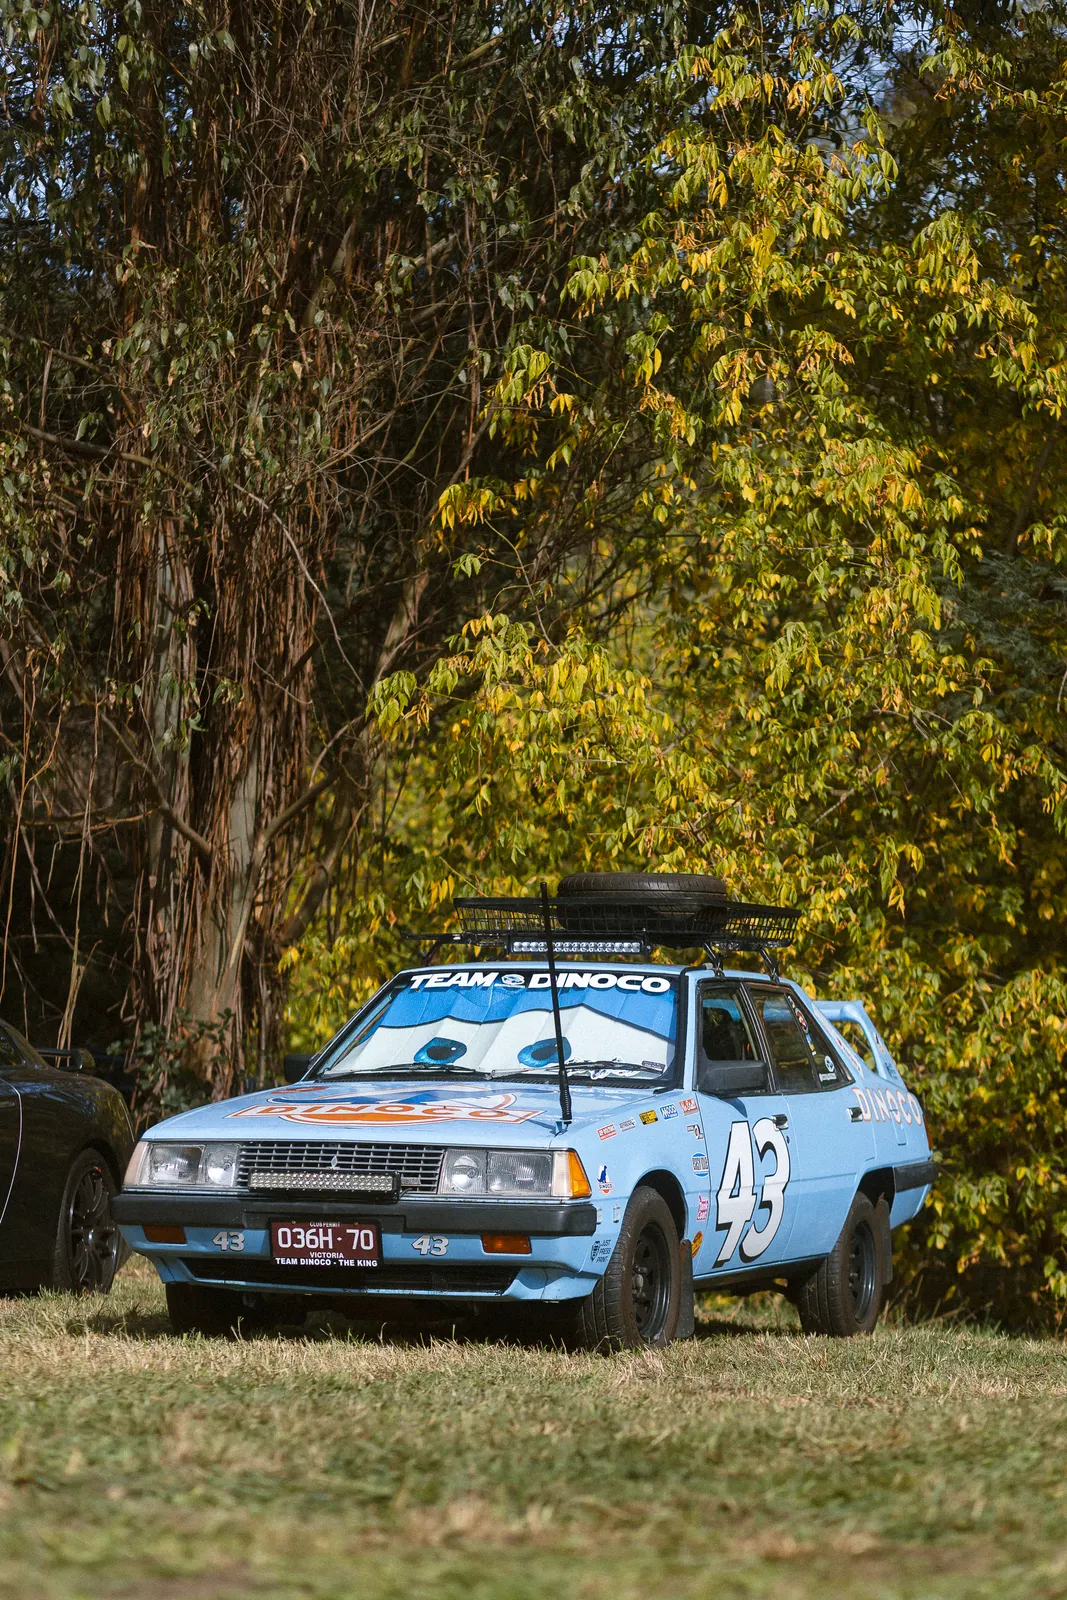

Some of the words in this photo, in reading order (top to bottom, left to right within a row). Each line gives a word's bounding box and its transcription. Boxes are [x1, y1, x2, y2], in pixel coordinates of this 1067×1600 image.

[410, 972, 500, 990] TEAM
[528, 973, 671, 993] DINOCO
[257, 1104, 510, 1118] DINOCO
[851, 1087, 922, 1126] DINOCO
[712, 1117, 791, 1269] 43
[212, 1231, 245, 1251] 43
[411, 1234, 449, 1256] 43
[275, 1257, 298, 1265] TEAM
[300, 1258, 331, 1266] DINOCO
[338, 1259, 354, 1267] THE
[357, 1259, 378, 1267] KING
[309, 1251, 345, 1259] VICTORIA
